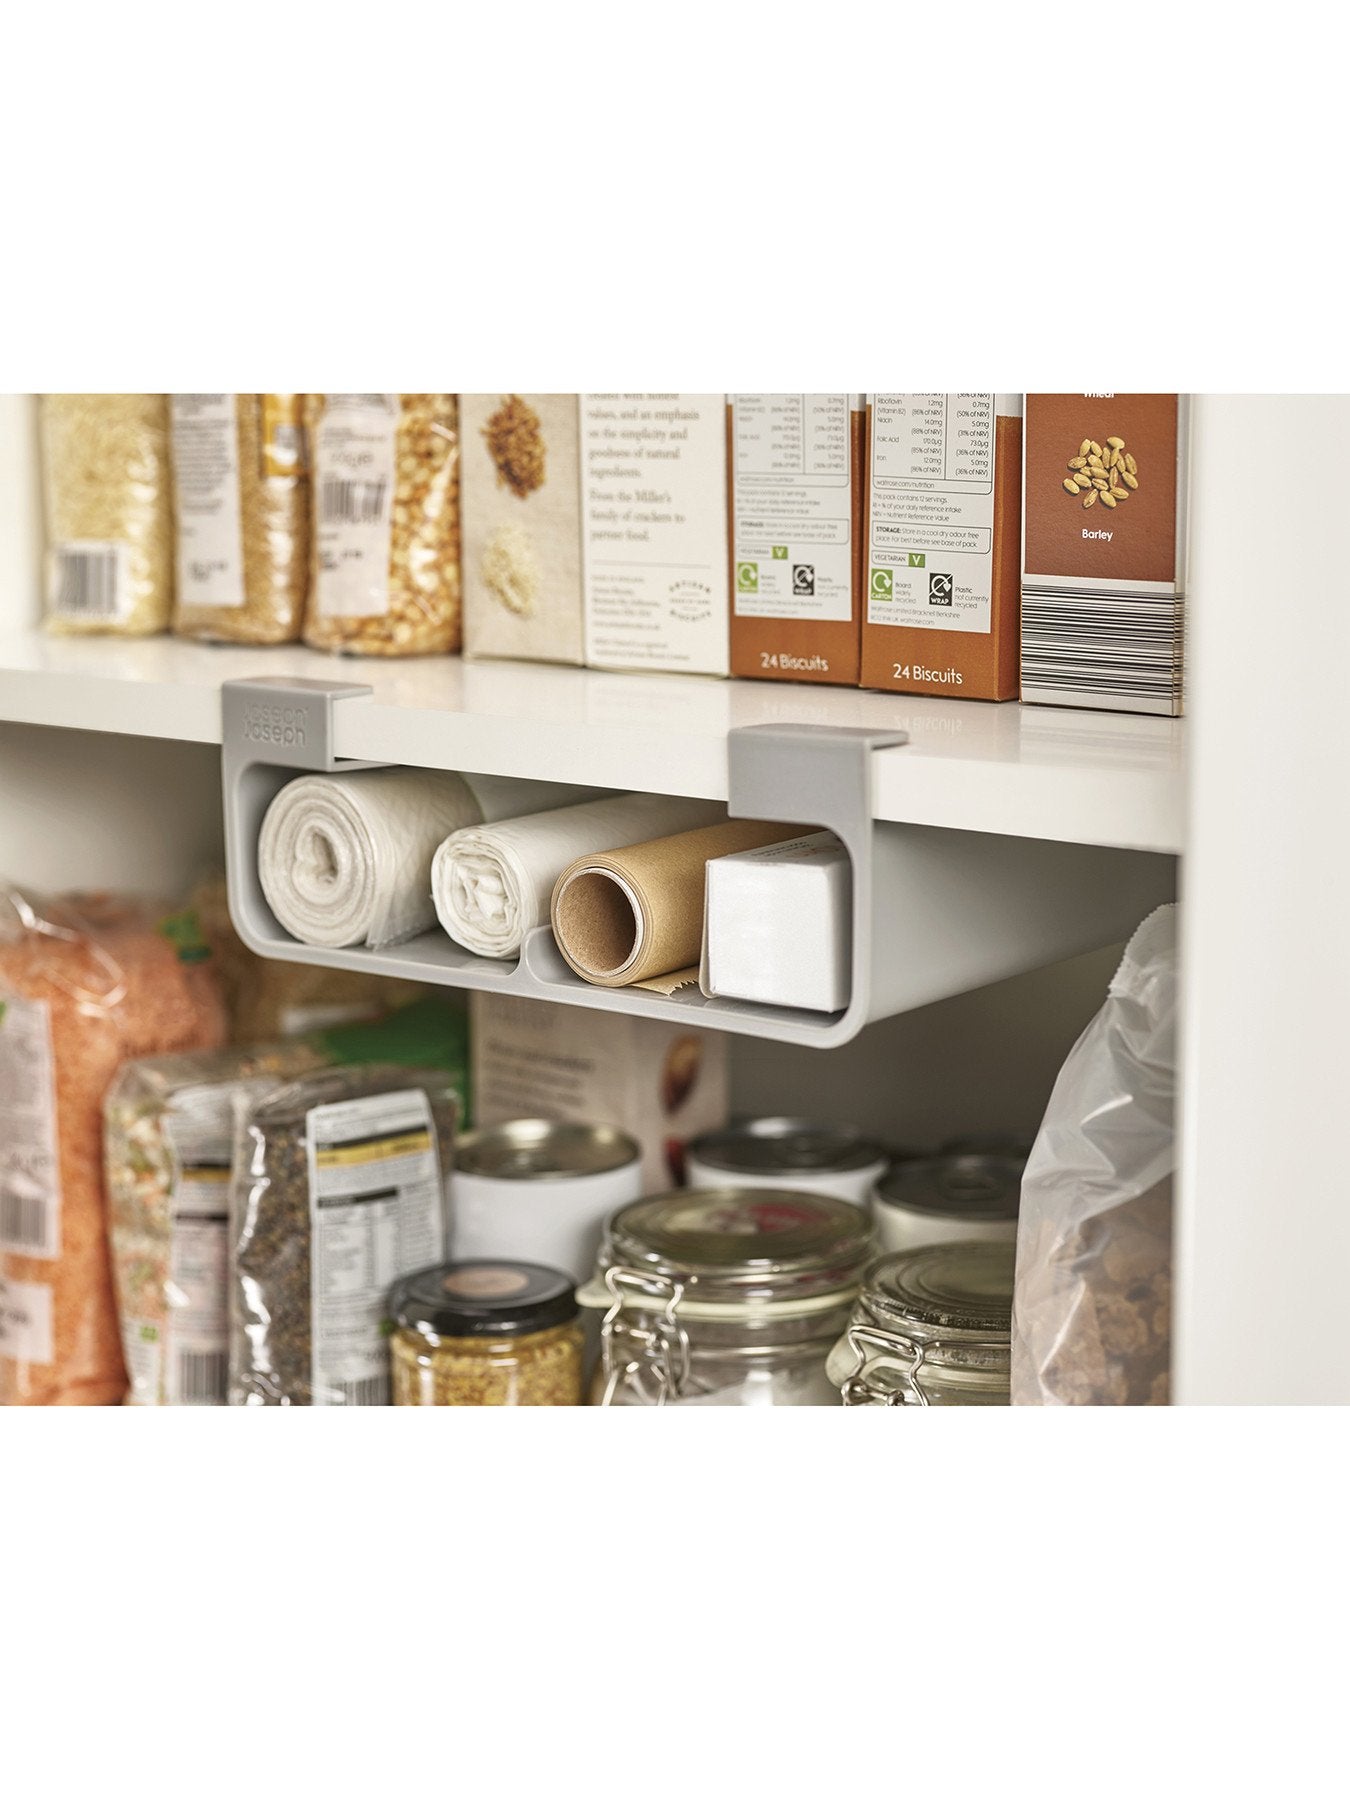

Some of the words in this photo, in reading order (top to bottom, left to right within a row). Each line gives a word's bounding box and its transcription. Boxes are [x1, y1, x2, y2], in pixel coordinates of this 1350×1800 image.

[654, 408, 700, 424] emphasis
[620, 428, 666, 444] simplicity
[670, 428, 688, 439] and
[1082, 528, 1113, 542] Barley
[965, 596, 989, 604] currently
[760, 652, 778, 669] 24
[780, 654, 829, 672] Biscuits
[893, 663, 910, 679] 24
[913, 665, 963, 684] Biscuits
[243, 720, 306, 746] Joseph
